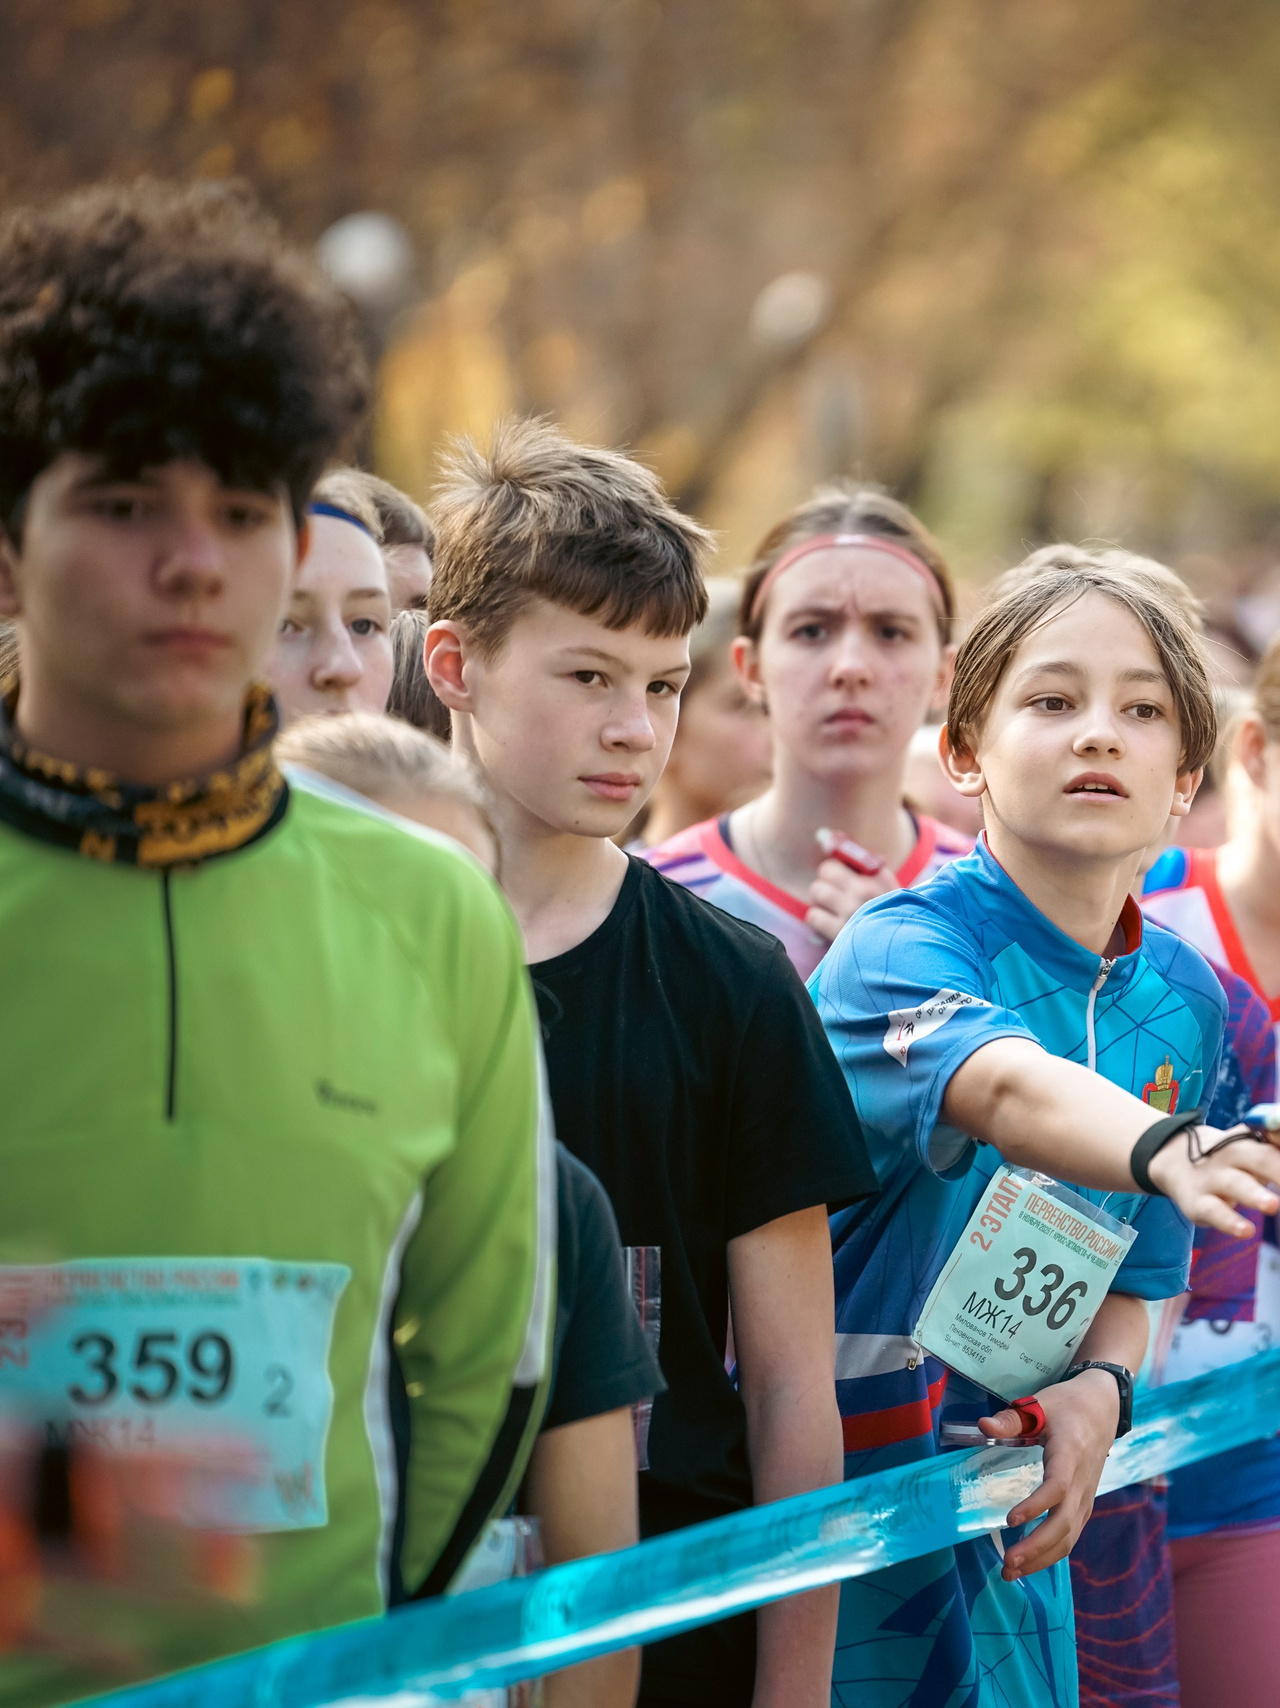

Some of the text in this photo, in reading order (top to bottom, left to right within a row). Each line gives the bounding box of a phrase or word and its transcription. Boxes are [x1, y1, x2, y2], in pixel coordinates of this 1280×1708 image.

[970, 1176, 1023, 1251] 2 ЭТАП
[1021, 1213, 1041, 1228] НОЯБРЯ
[1024, 1192, 1086, 1239] ПЕРВЕНСТВО
[1086, 1229, 1121, 1261] РОССИИ
[994, 1247, 1088, 1330] 336
[949, 1323, 992, 1355] Пензенская обл.
[954, 1313, 987, 1337] Милованов
[962, 1291, 1023, 1339] МЖ14
[69, 1330, 235, 1404] 359
[962, 1345, 986, 1363] 8534115
[262, 1364, 294, 1417] 2
